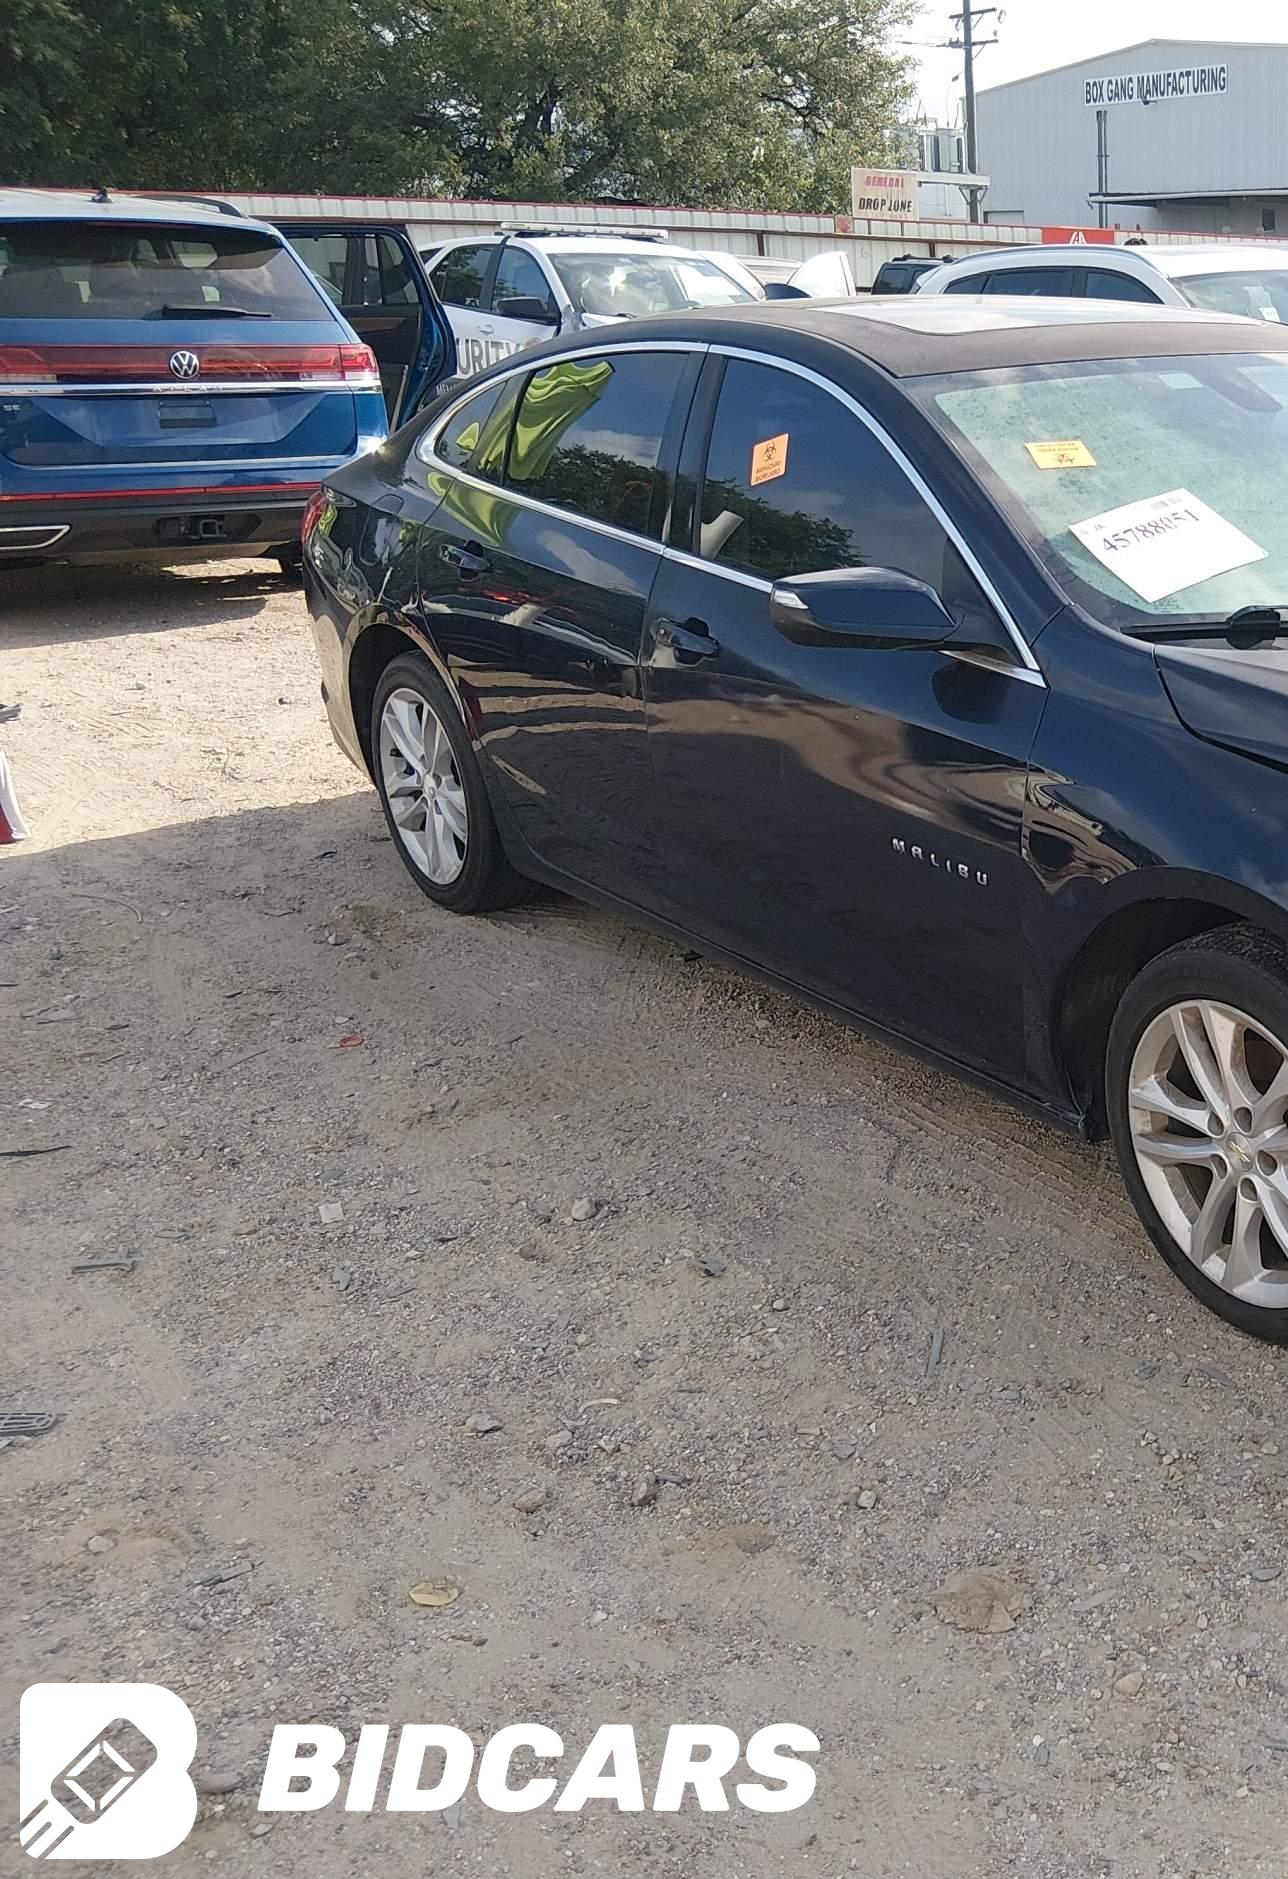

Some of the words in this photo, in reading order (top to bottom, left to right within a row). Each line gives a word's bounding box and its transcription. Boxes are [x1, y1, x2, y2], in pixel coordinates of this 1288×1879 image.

[1085, 80, 1105, 104] BOX
[1106, 77, 1134, 102] GANG
[1136, 66, 1226, 99] MANUFACTURING
[865, 175, 904, 188] GENERAL
[858, 197, 887, 211] DROP
[887, 199, 912, 213] ZONE
[3, 404, 21, 412] SE
[1103, 508, 1200, 551] 45788051
[892, 838, 988, 886] MALIBU
